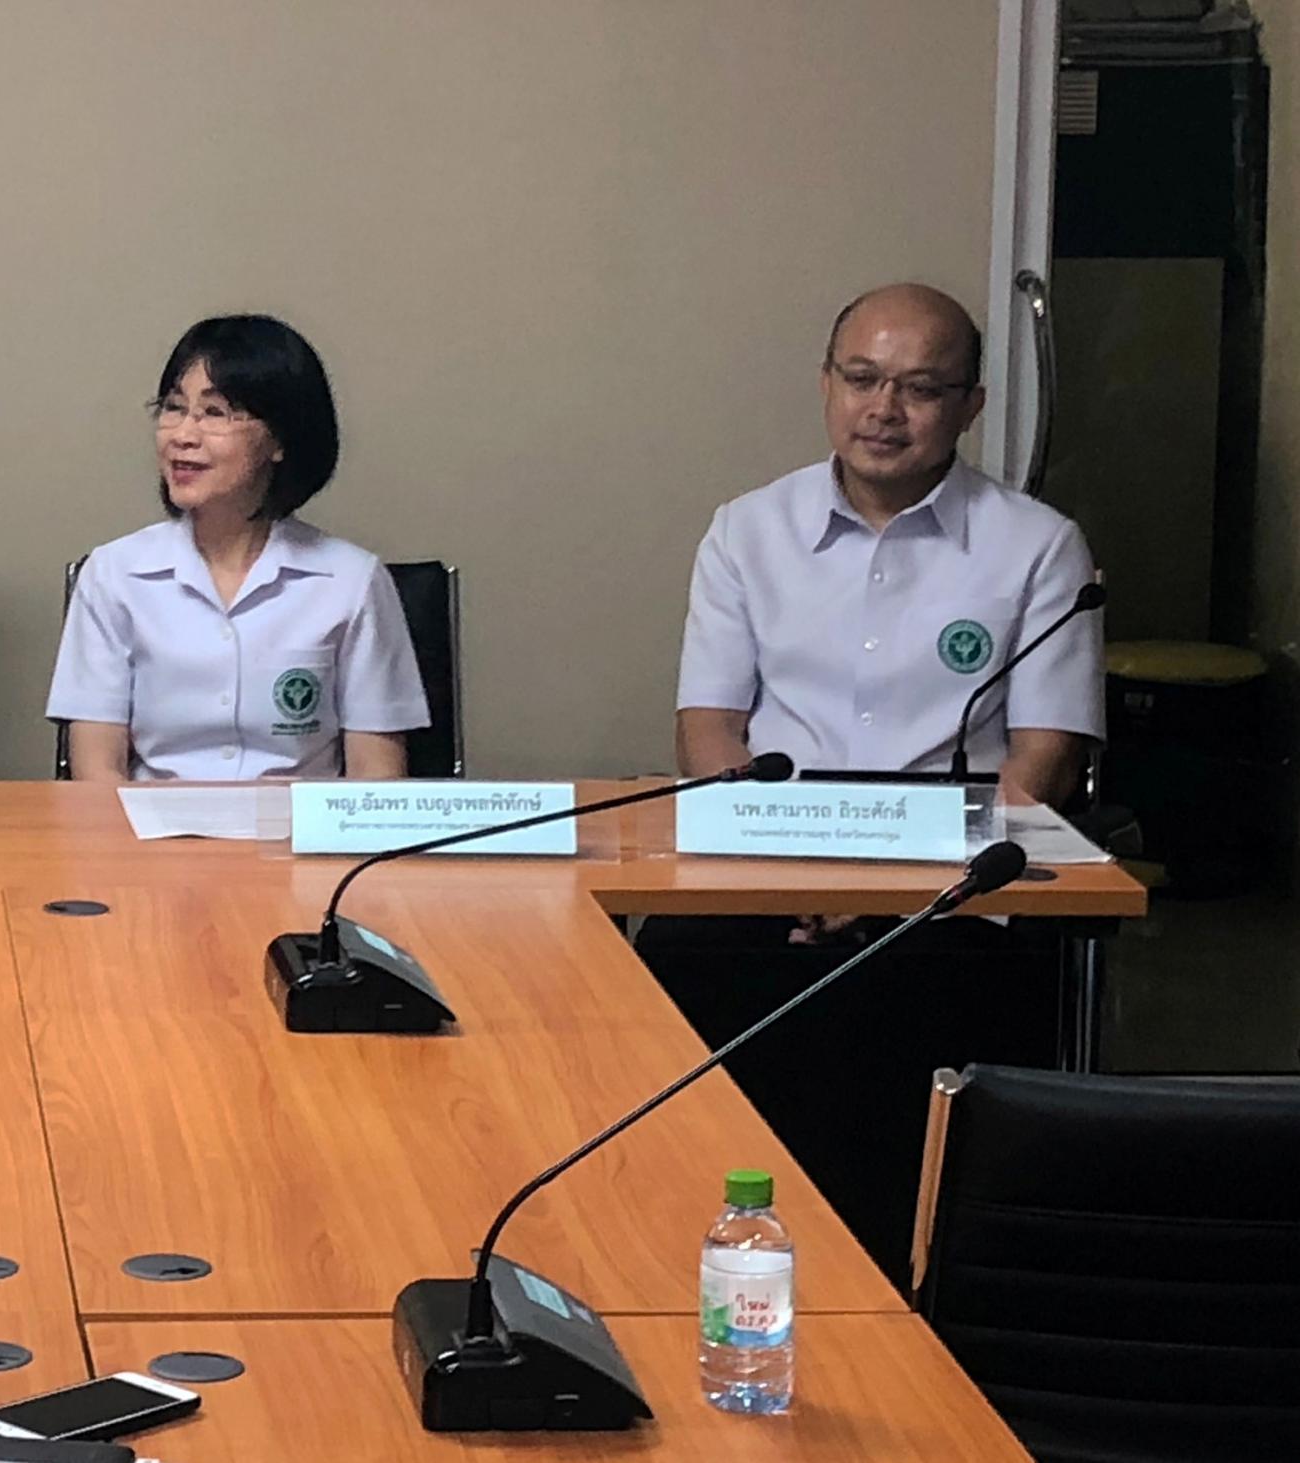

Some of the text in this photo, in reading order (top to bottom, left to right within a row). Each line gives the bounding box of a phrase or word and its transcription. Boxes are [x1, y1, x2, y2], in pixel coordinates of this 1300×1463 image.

[326, 792, 409, 816] พญ.อัมพร
[732, 801, 832, 819] นพ.สามารถ
